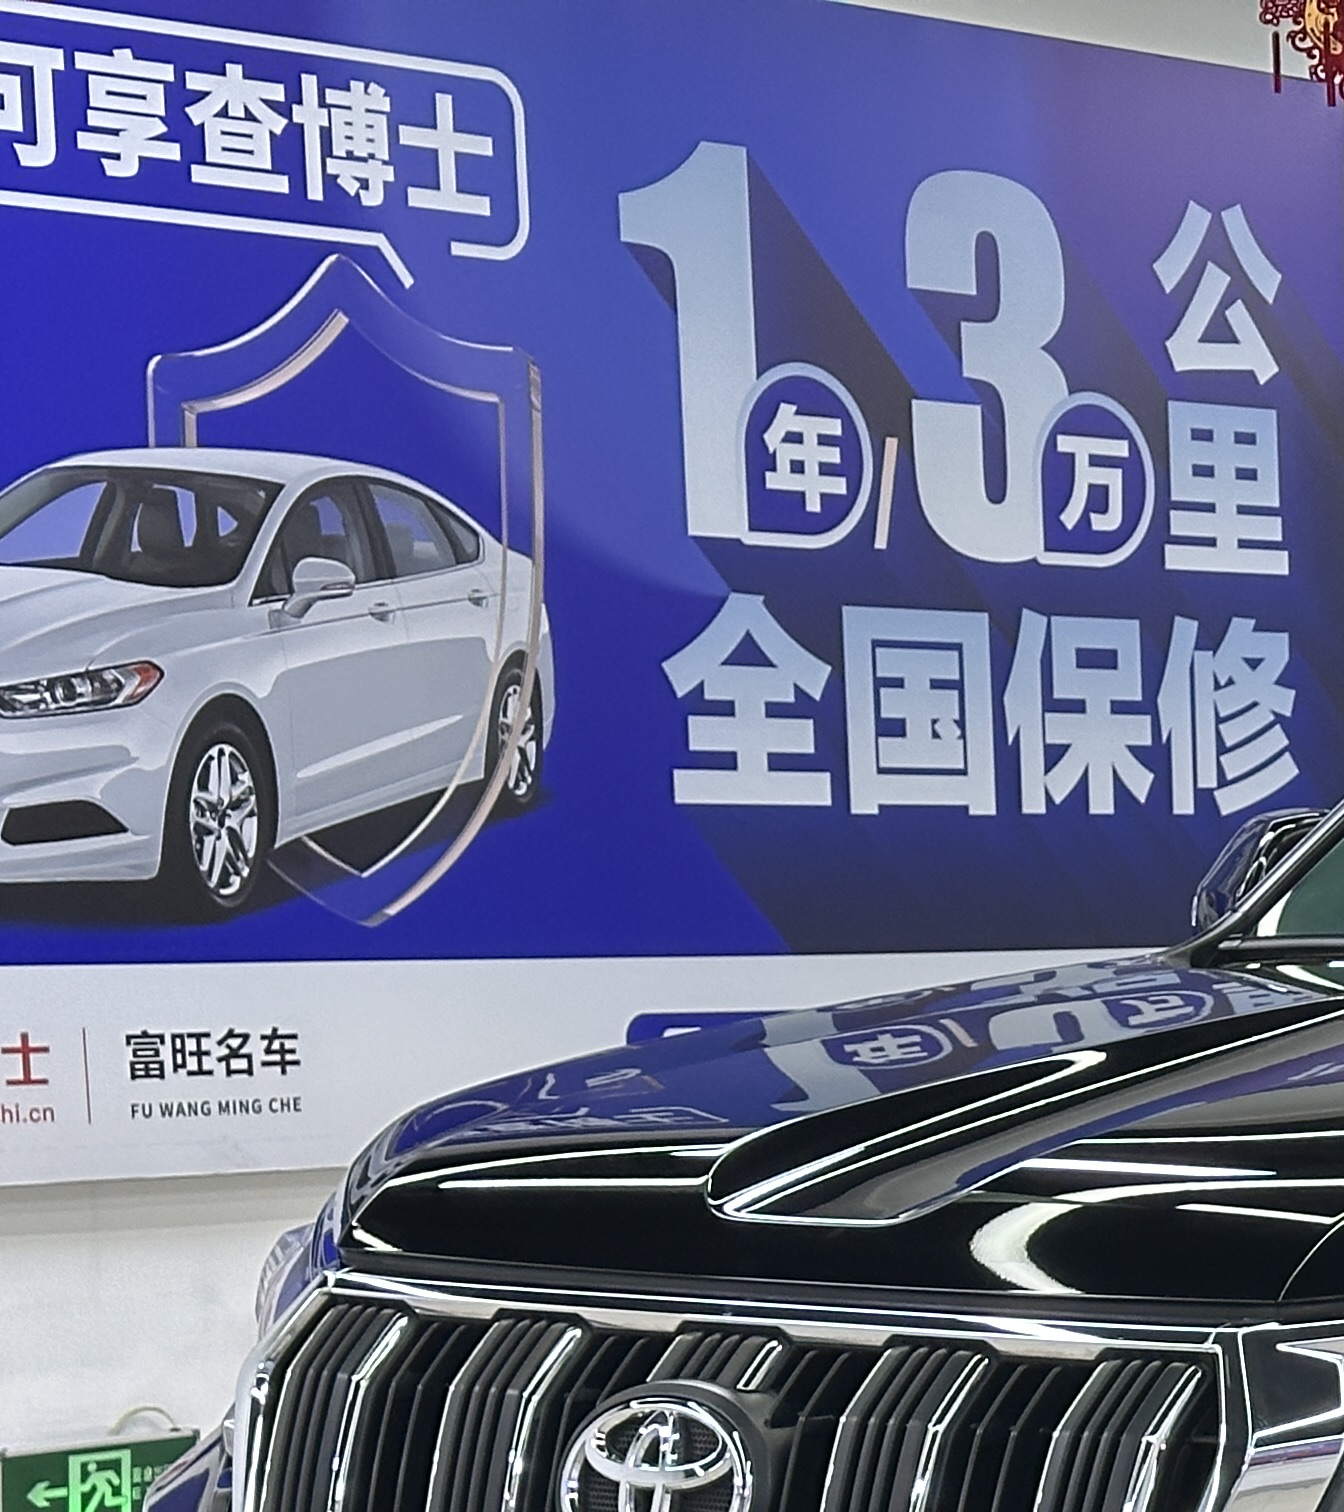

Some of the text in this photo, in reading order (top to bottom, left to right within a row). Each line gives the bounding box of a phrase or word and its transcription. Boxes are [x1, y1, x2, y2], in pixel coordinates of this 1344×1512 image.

[0, 41, 493, 216] 可享查博士
[661, 591, 1300, 817] 全国保修
[1, 1027, 301, 1085] 士 富旺名车
[130, 1102, 152, 1119] FU
[160, 1100, 212, 1118] WANG
[218, 1098, 263, 1115] MING
[268, 1096, 302, 1113] CHE
